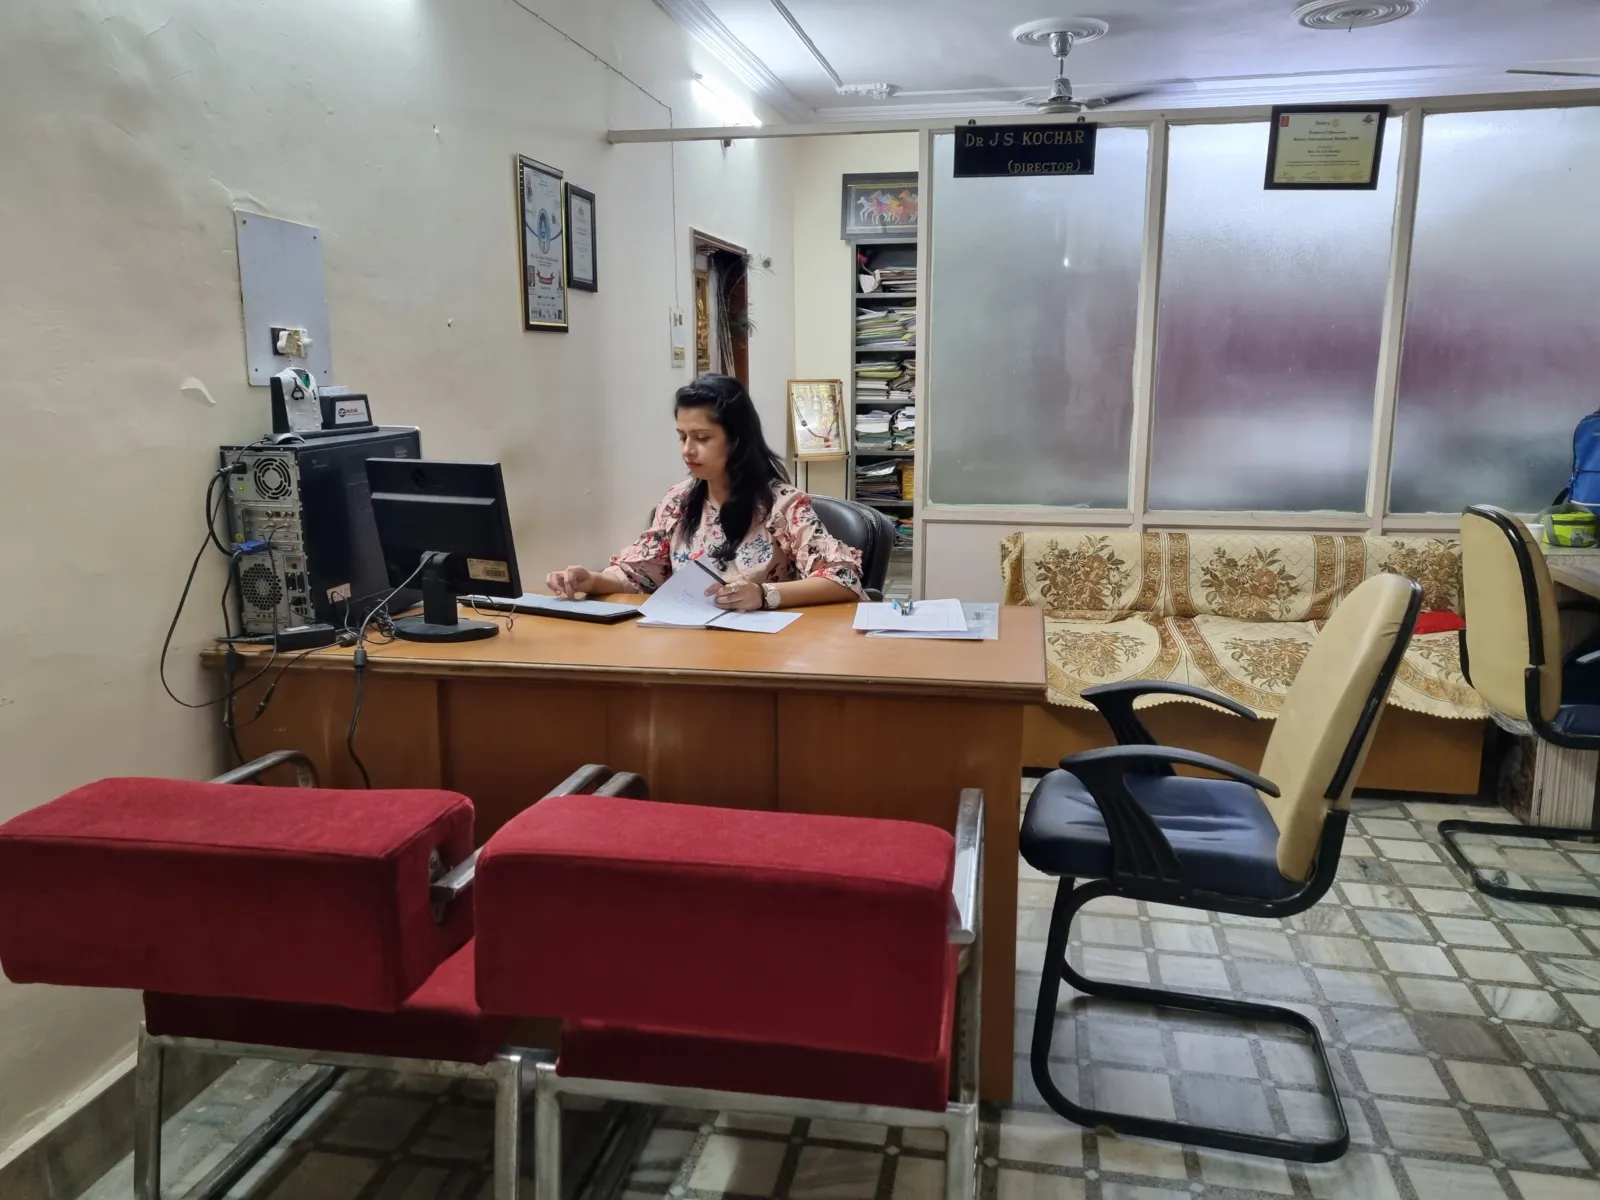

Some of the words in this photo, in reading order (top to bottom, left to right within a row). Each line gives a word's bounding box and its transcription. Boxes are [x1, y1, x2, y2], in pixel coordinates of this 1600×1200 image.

[989, 132, 999, 147] J
[1003, 132, 1015, 146] S
[1022, 130, 1085, 146] KOCHAR
[1008, 159, 1081, 174] (DIRECTOR)
